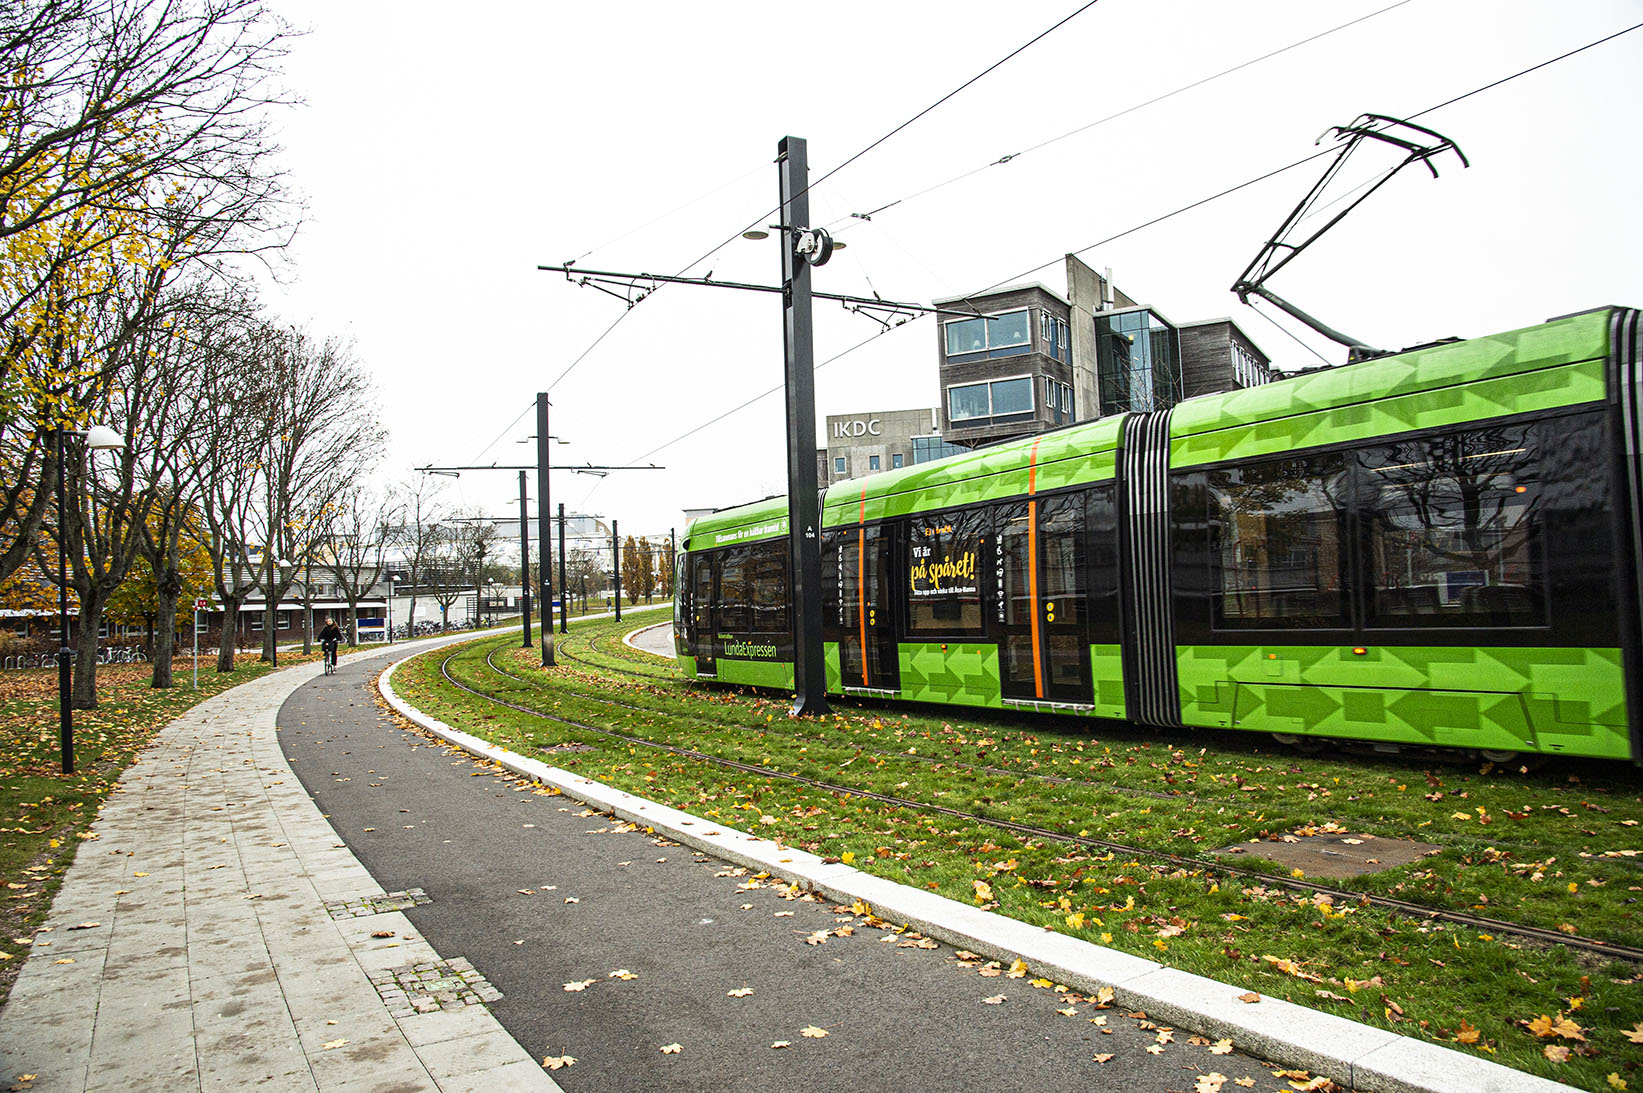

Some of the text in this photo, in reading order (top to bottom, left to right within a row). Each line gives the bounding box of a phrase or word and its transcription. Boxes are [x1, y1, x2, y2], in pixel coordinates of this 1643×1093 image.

[834, 419, 880, 438] IKDC
[913, 546, 931, 558] Vi är
[911, 551, 975, 590] på spåret!
[724, 640, 777, 659] LundaExpressen
